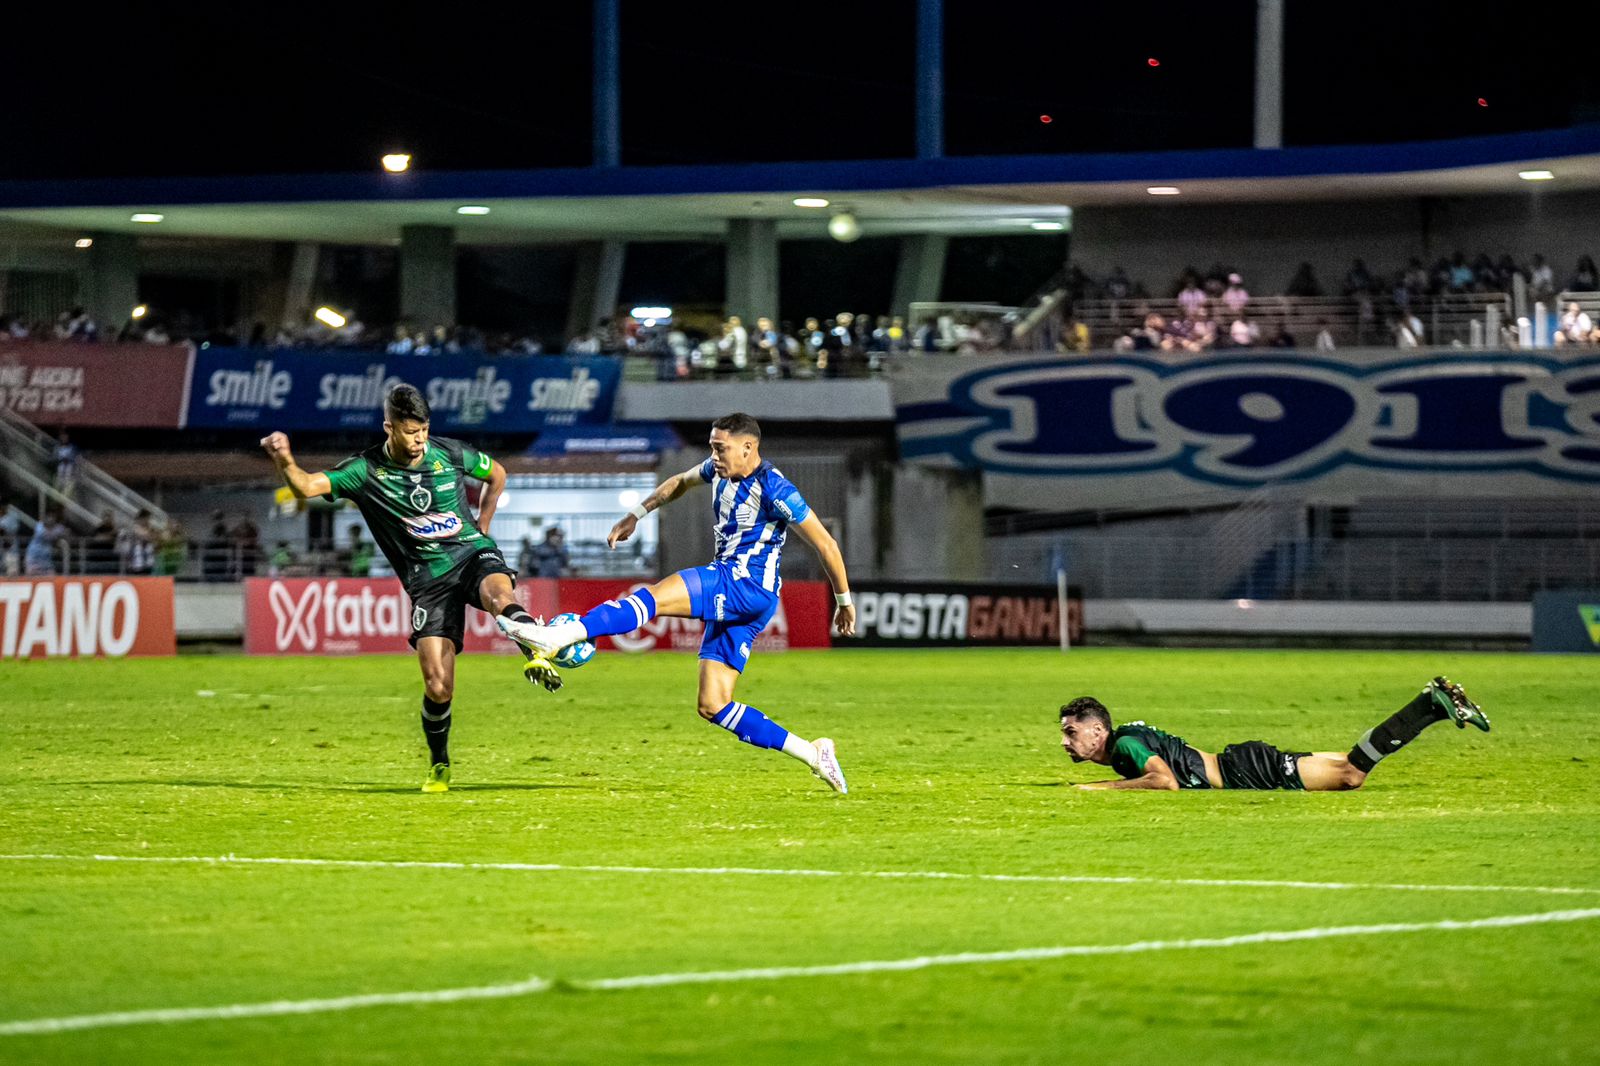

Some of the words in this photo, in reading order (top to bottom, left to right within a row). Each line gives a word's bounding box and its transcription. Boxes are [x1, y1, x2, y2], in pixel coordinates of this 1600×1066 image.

[206, 360, 292, 409] smile
[426, 366, 511, 413] smile
[527, 367, 600, 412] smile
[0, 581, 139, 657] TANO
[832, 592, 968, 638] POSTA
